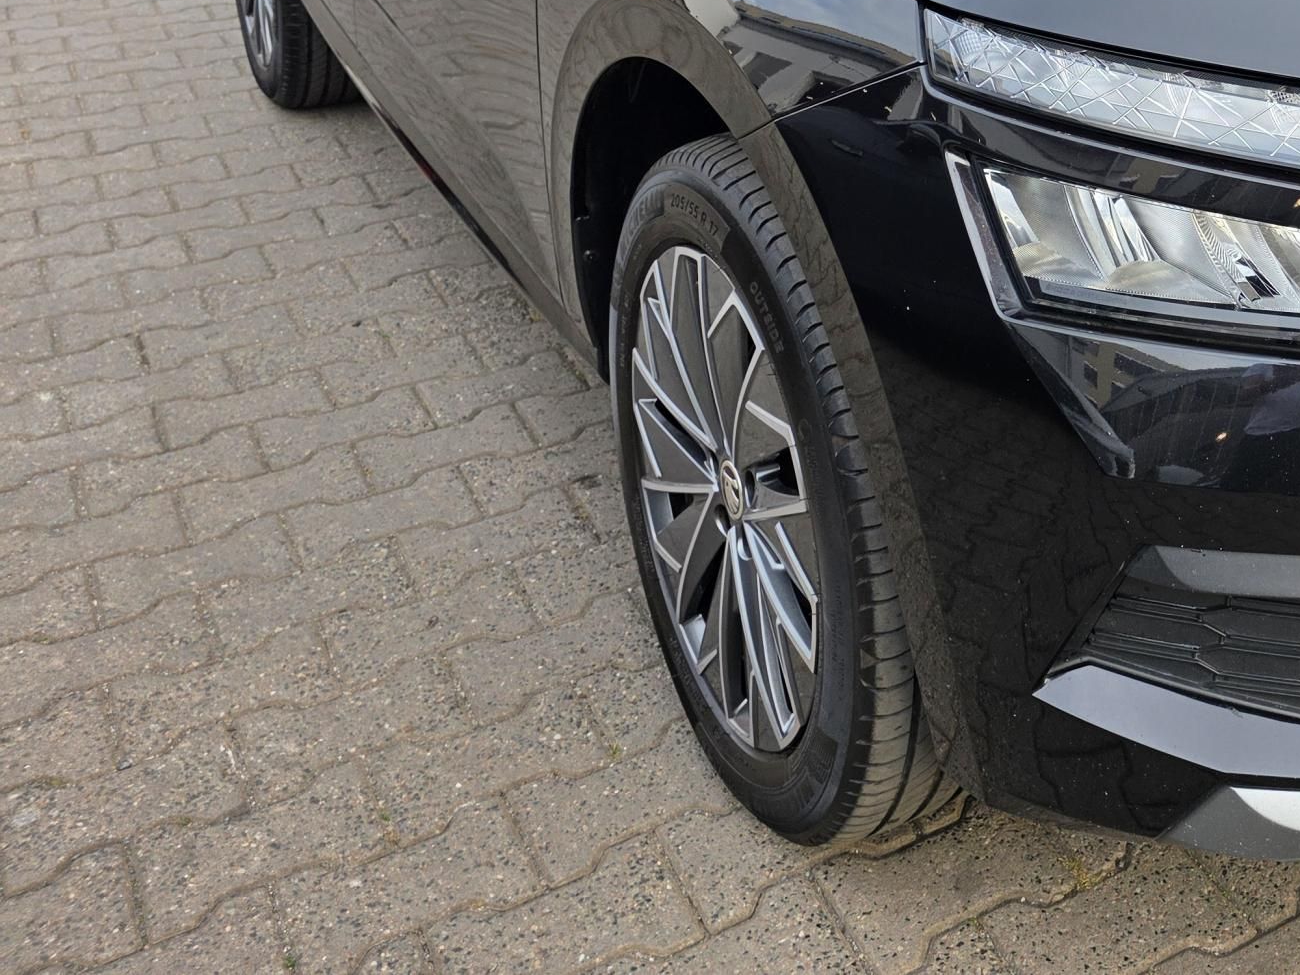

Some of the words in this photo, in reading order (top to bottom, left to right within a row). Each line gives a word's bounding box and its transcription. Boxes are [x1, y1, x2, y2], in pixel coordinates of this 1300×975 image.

[670, 192, 700, 220] 205/55
[699, 211, 708, 226] R
[708, 219, 720, 237] 17
[749, 280, 785, 355] OUTSIDE
